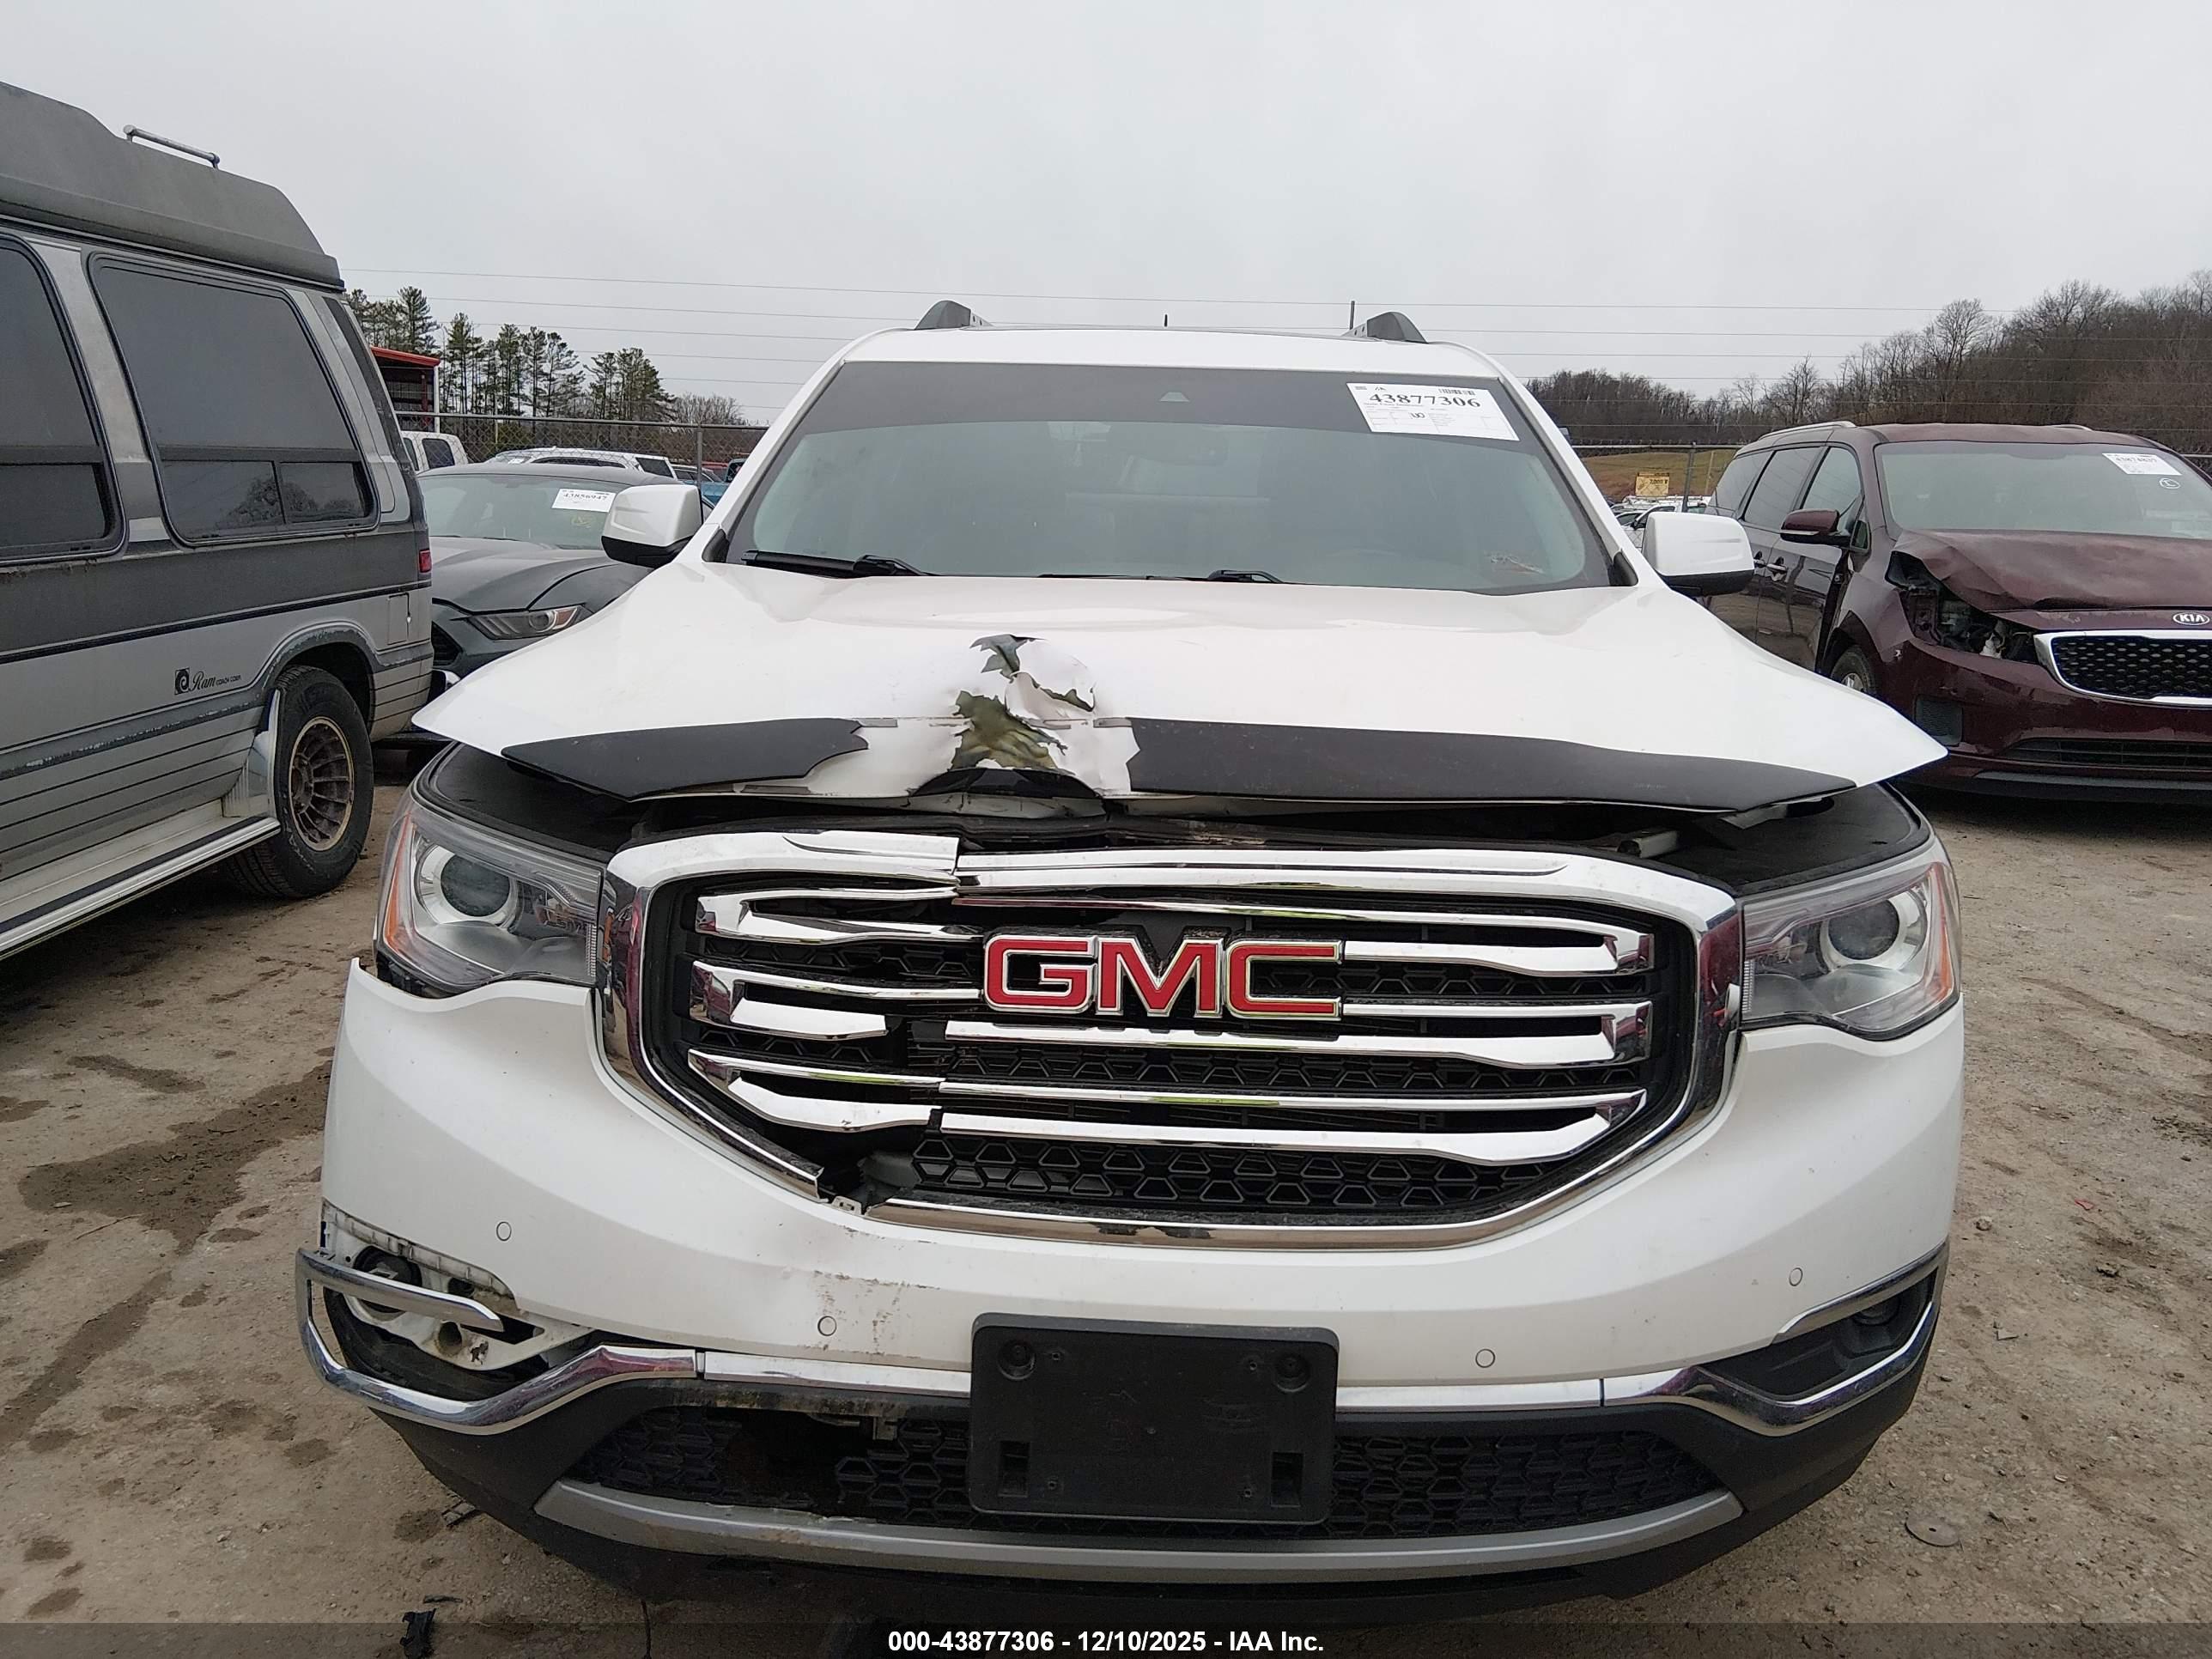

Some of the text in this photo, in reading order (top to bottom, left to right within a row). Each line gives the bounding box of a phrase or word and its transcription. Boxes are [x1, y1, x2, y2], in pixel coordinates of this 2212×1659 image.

[1369, 393, 1481, 408] 43877306
[2179, 614, 2205, 623] KIA
[189, 671, 216, 691] Ram
[983, 934, 1343, 1021] GMC
